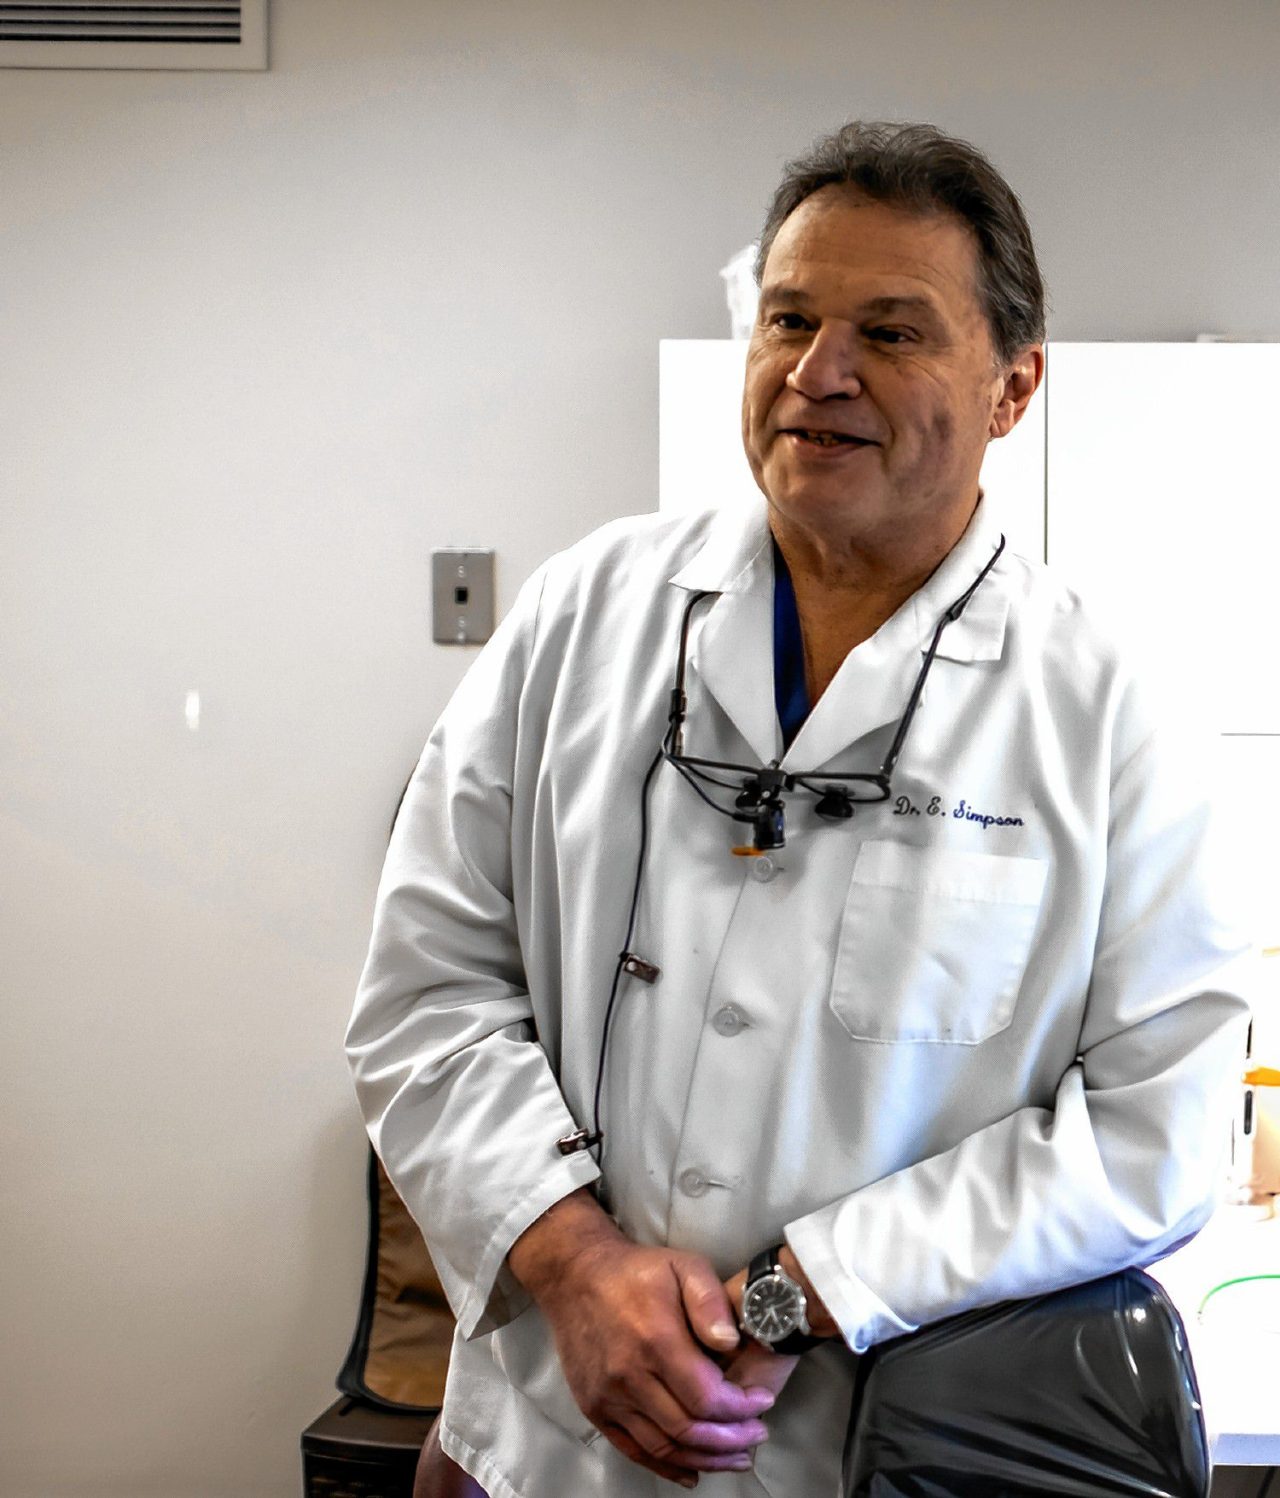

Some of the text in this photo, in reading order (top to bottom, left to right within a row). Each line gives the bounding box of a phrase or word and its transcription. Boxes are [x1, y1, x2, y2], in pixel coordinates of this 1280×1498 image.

[893, 796, 1024, 829] Dr. E. Simpson
